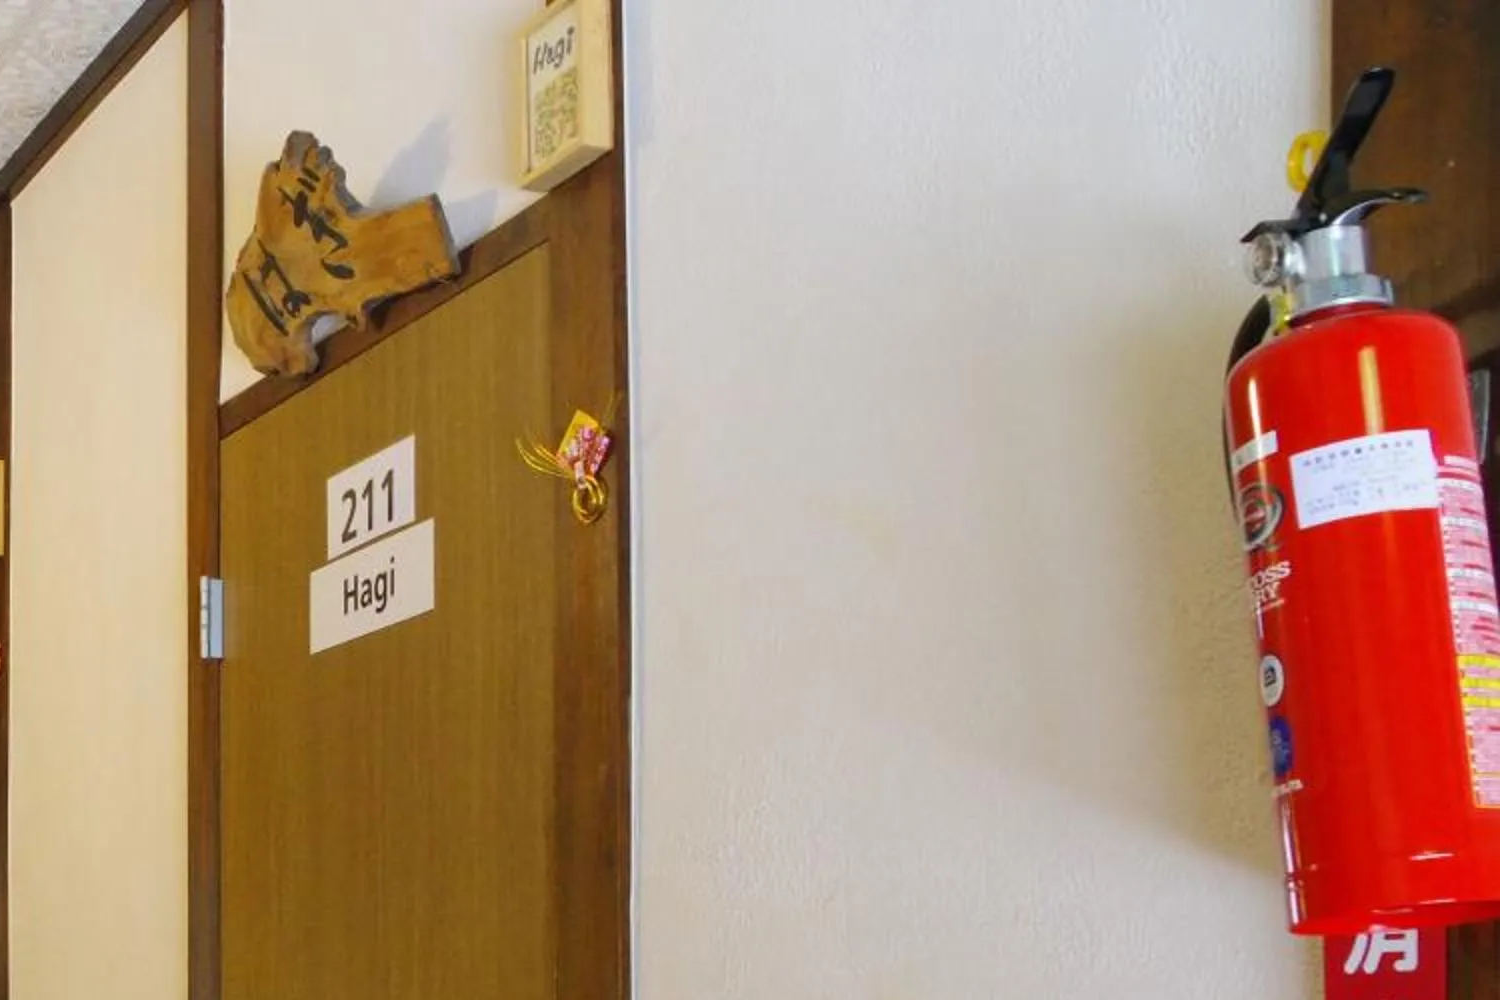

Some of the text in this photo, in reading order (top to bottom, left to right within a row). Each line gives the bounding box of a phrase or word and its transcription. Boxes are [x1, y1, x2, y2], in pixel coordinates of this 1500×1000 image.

[533, 26, 575, 74] Hagi
[341, 469, 394, 544] 211
[343, 557, 396, 615] Hagi
